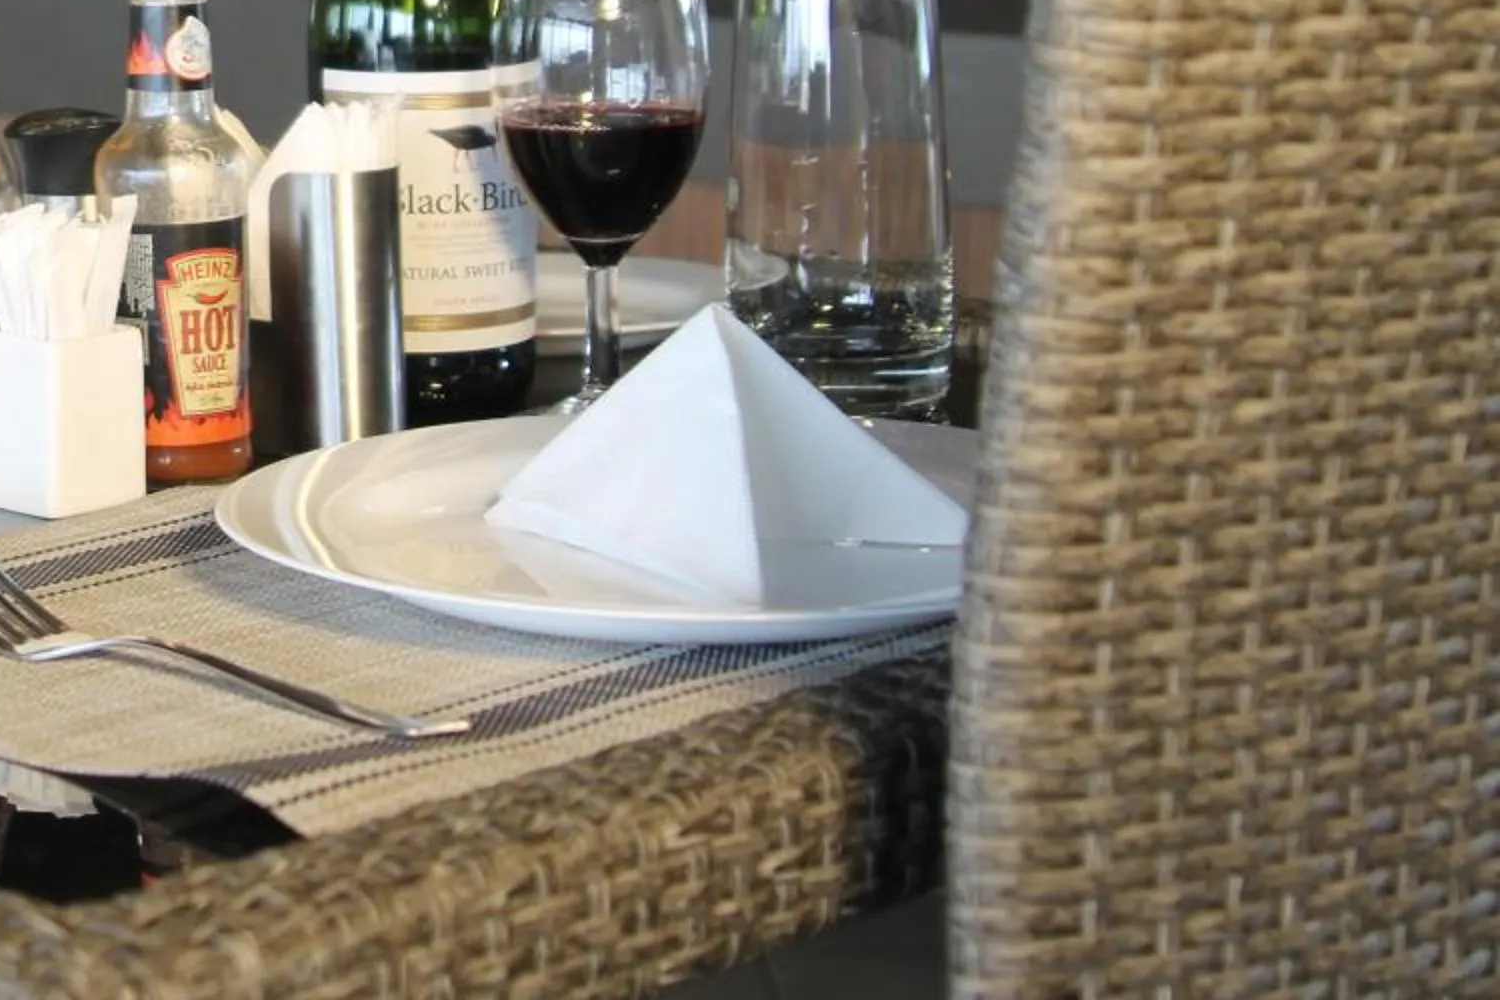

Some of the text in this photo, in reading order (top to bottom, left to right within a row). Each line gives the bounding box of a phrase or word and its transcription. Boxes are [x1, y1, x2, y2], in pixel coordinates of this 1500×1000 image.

[181, 260, 232, 283] HEINZ
[402, 265, 458, 281] ATURAL
[464, 260, 505, 278] SWEET
[180, 305, 236, 354] HOT
[193, 353, 228, 373] SAUCE
